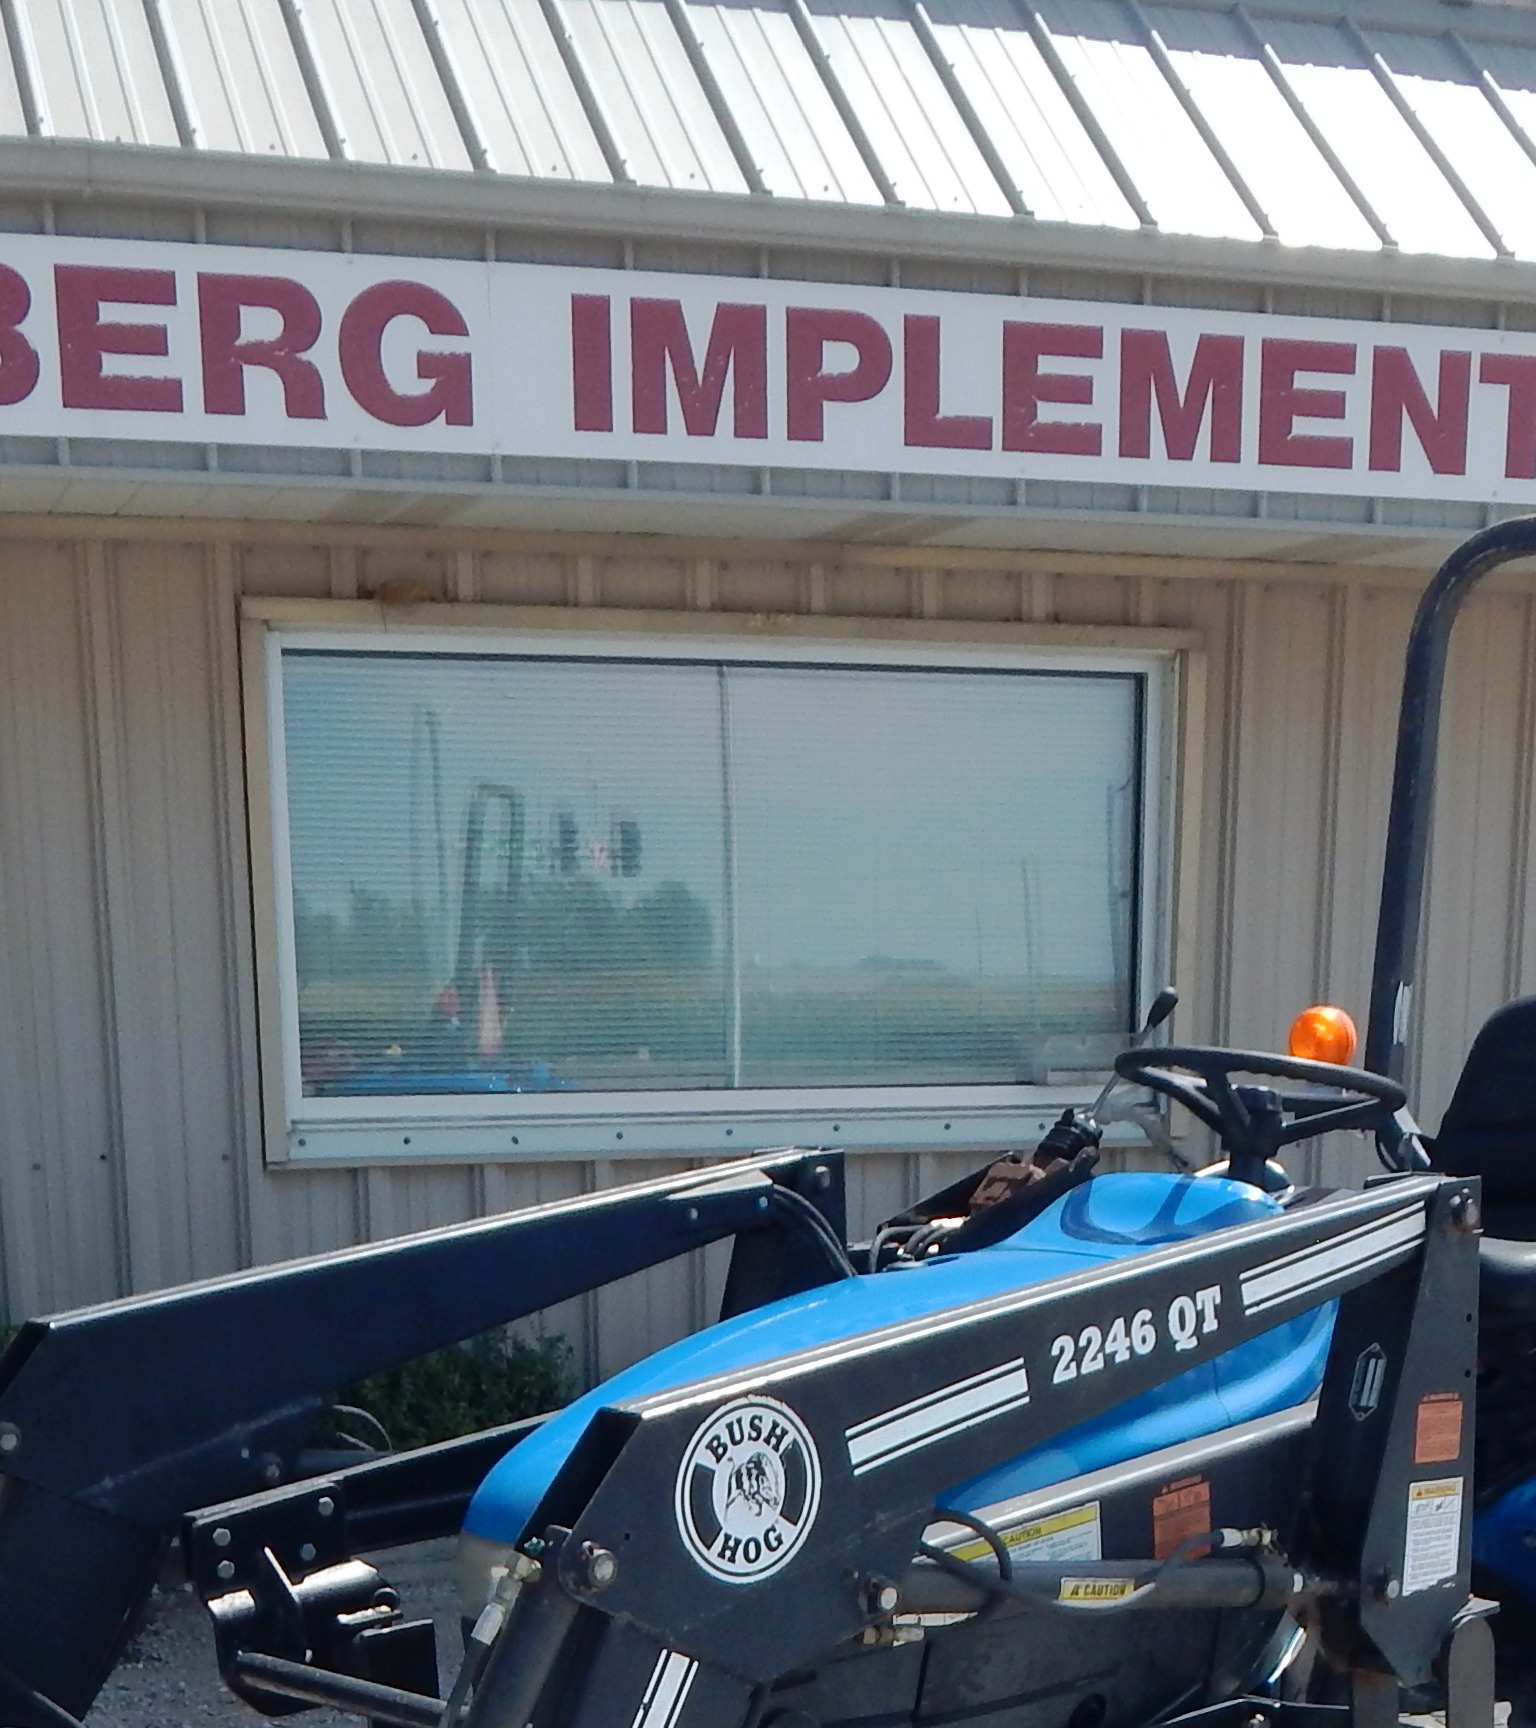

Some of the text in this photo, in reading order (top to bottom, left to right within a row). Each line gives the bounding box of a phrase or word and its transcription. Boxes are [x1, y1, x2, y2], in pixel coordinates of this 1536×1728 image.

[1051, 1285, 1222, 1385] 2246 QT
[704, 1414, 789, 1464] BUSH
[716, 1524, 784, 1565] HOG
[1004, 1527, 1042, 1543] CAUTION
[1084, 1583, 1127, 1596] CAUTION
